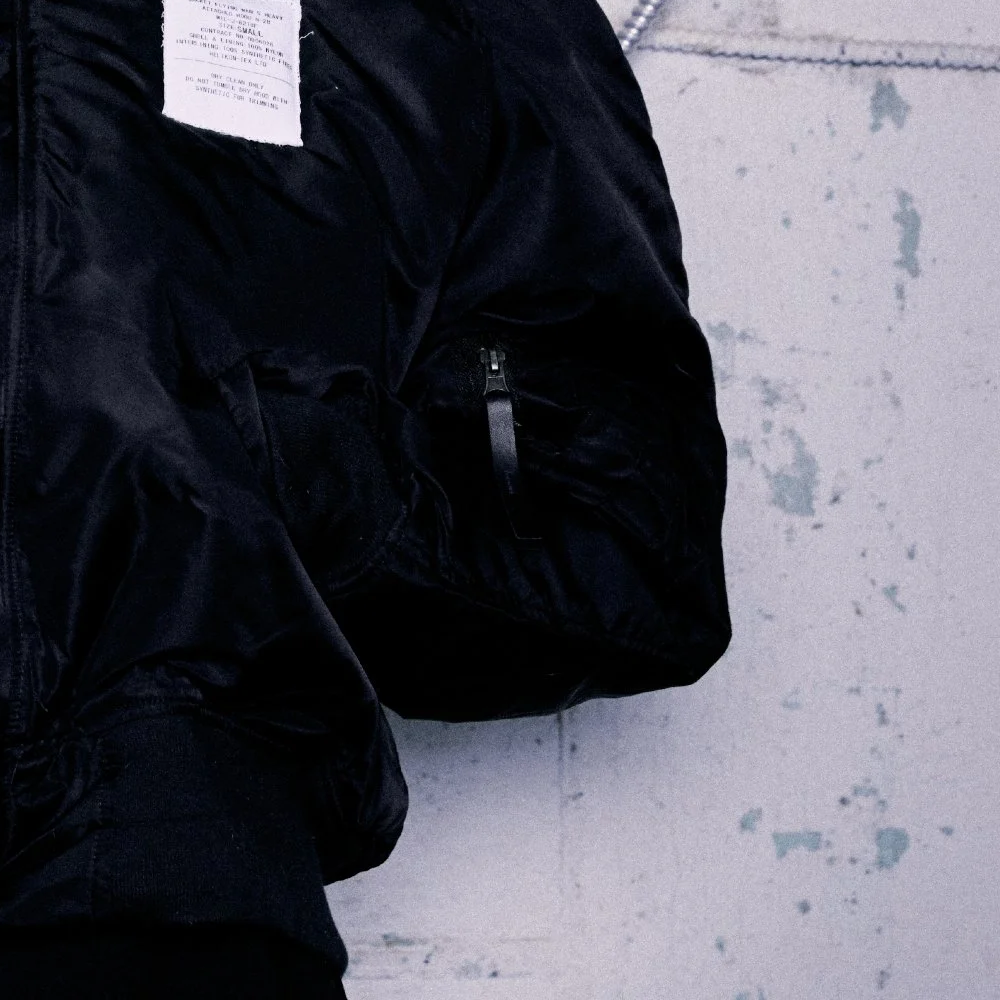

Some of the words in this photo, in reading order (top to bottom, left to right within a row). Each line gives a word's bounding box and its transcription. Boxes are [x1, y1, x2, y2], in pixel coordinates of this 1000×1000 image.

[200, 27, 231, 37] CONTRACT
[237, 25, 263, 38] SMALL
[220, 37, 244, 47] LINING
[197, 77, 210, 85] NOT
[225, 76, 246, 86] CLEAN
[248, 81, 264, 90] ONLY
[195, 85, 230, 98] SYNTHETIC
